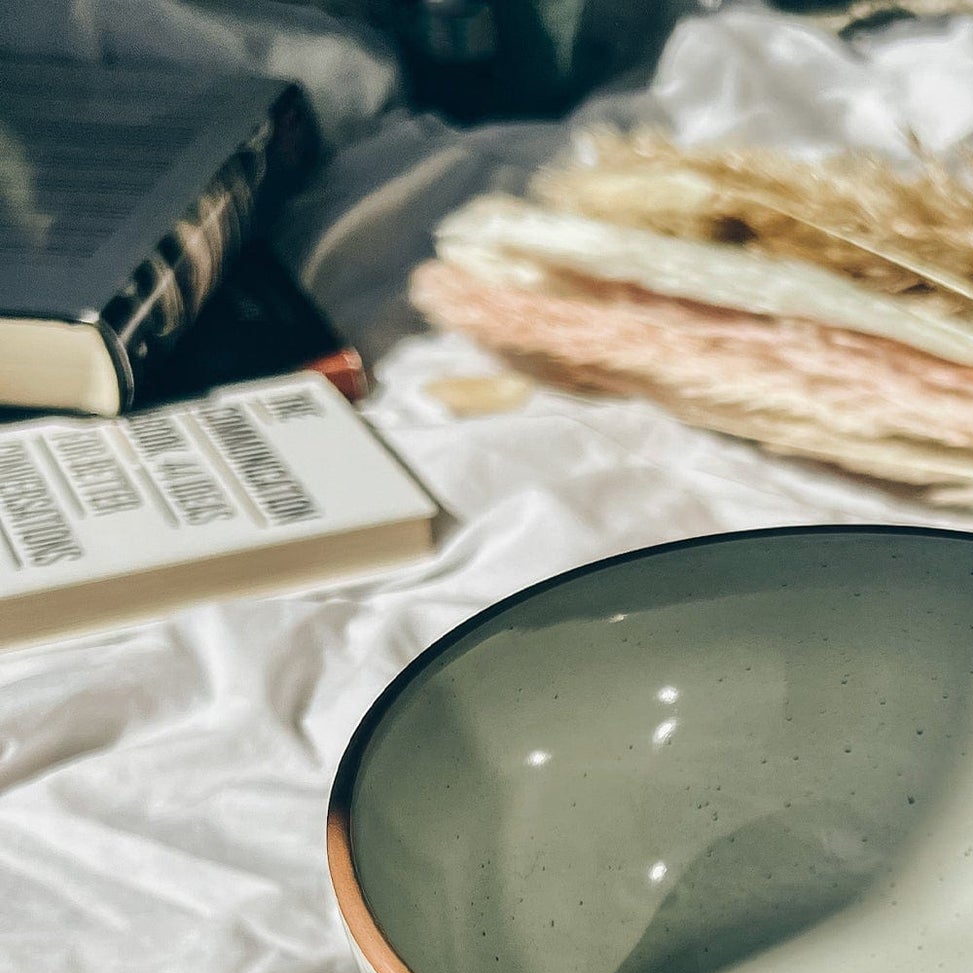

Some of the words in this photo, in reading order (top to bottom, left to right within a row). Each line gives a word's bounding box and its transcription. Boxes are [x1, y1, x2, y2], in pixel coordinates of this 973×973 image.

[69, 458, 142, 517] BETTER
[204, 407, 322, 525] COMMUNICATION
[168, 480, 236, 525] IDEAS
